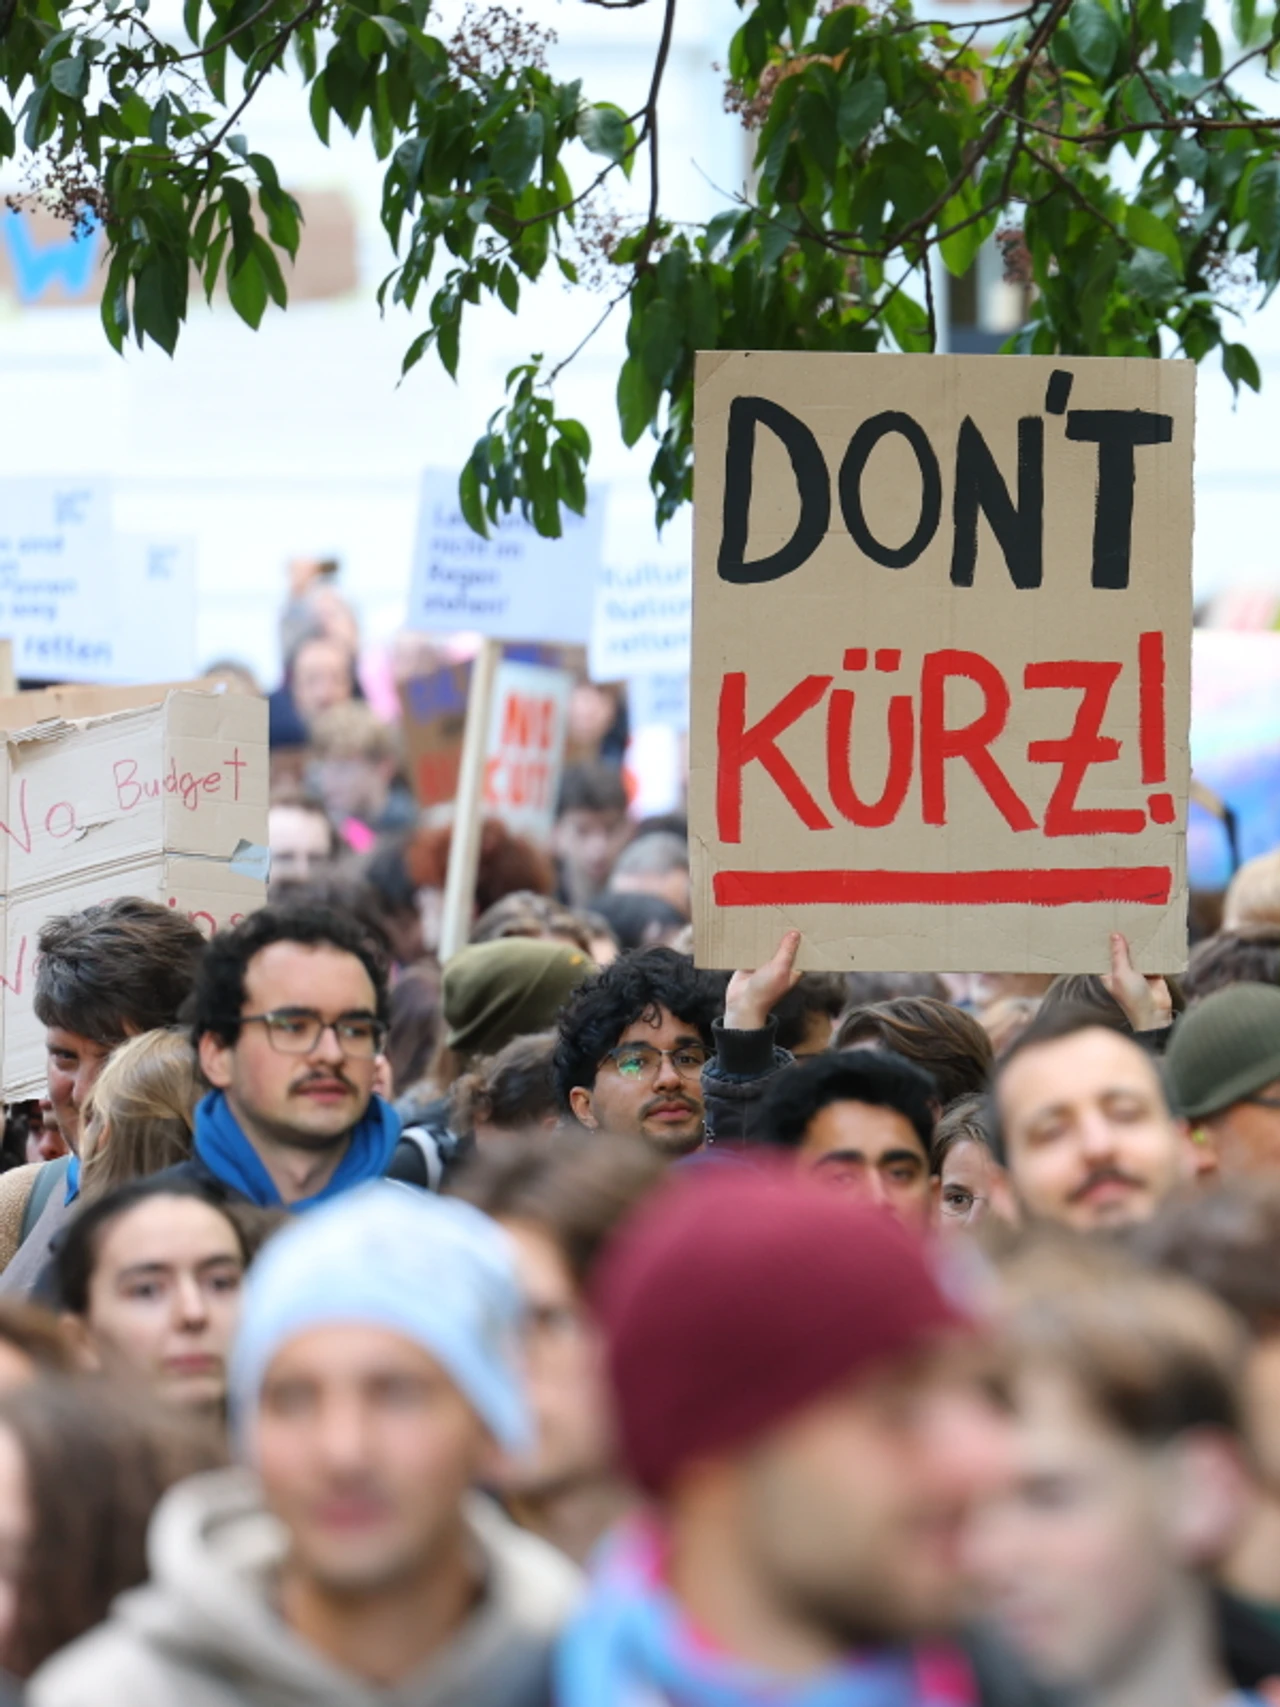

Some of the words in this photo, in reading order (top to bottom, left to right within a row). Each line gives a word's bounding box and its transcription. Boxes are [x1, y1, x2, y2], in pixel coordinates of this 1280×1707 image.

[717, 369, 1173, 589] DON'T
[113, 747, 248, 812] Budget
[716, 631, 1176, 844] KÜRZ!
